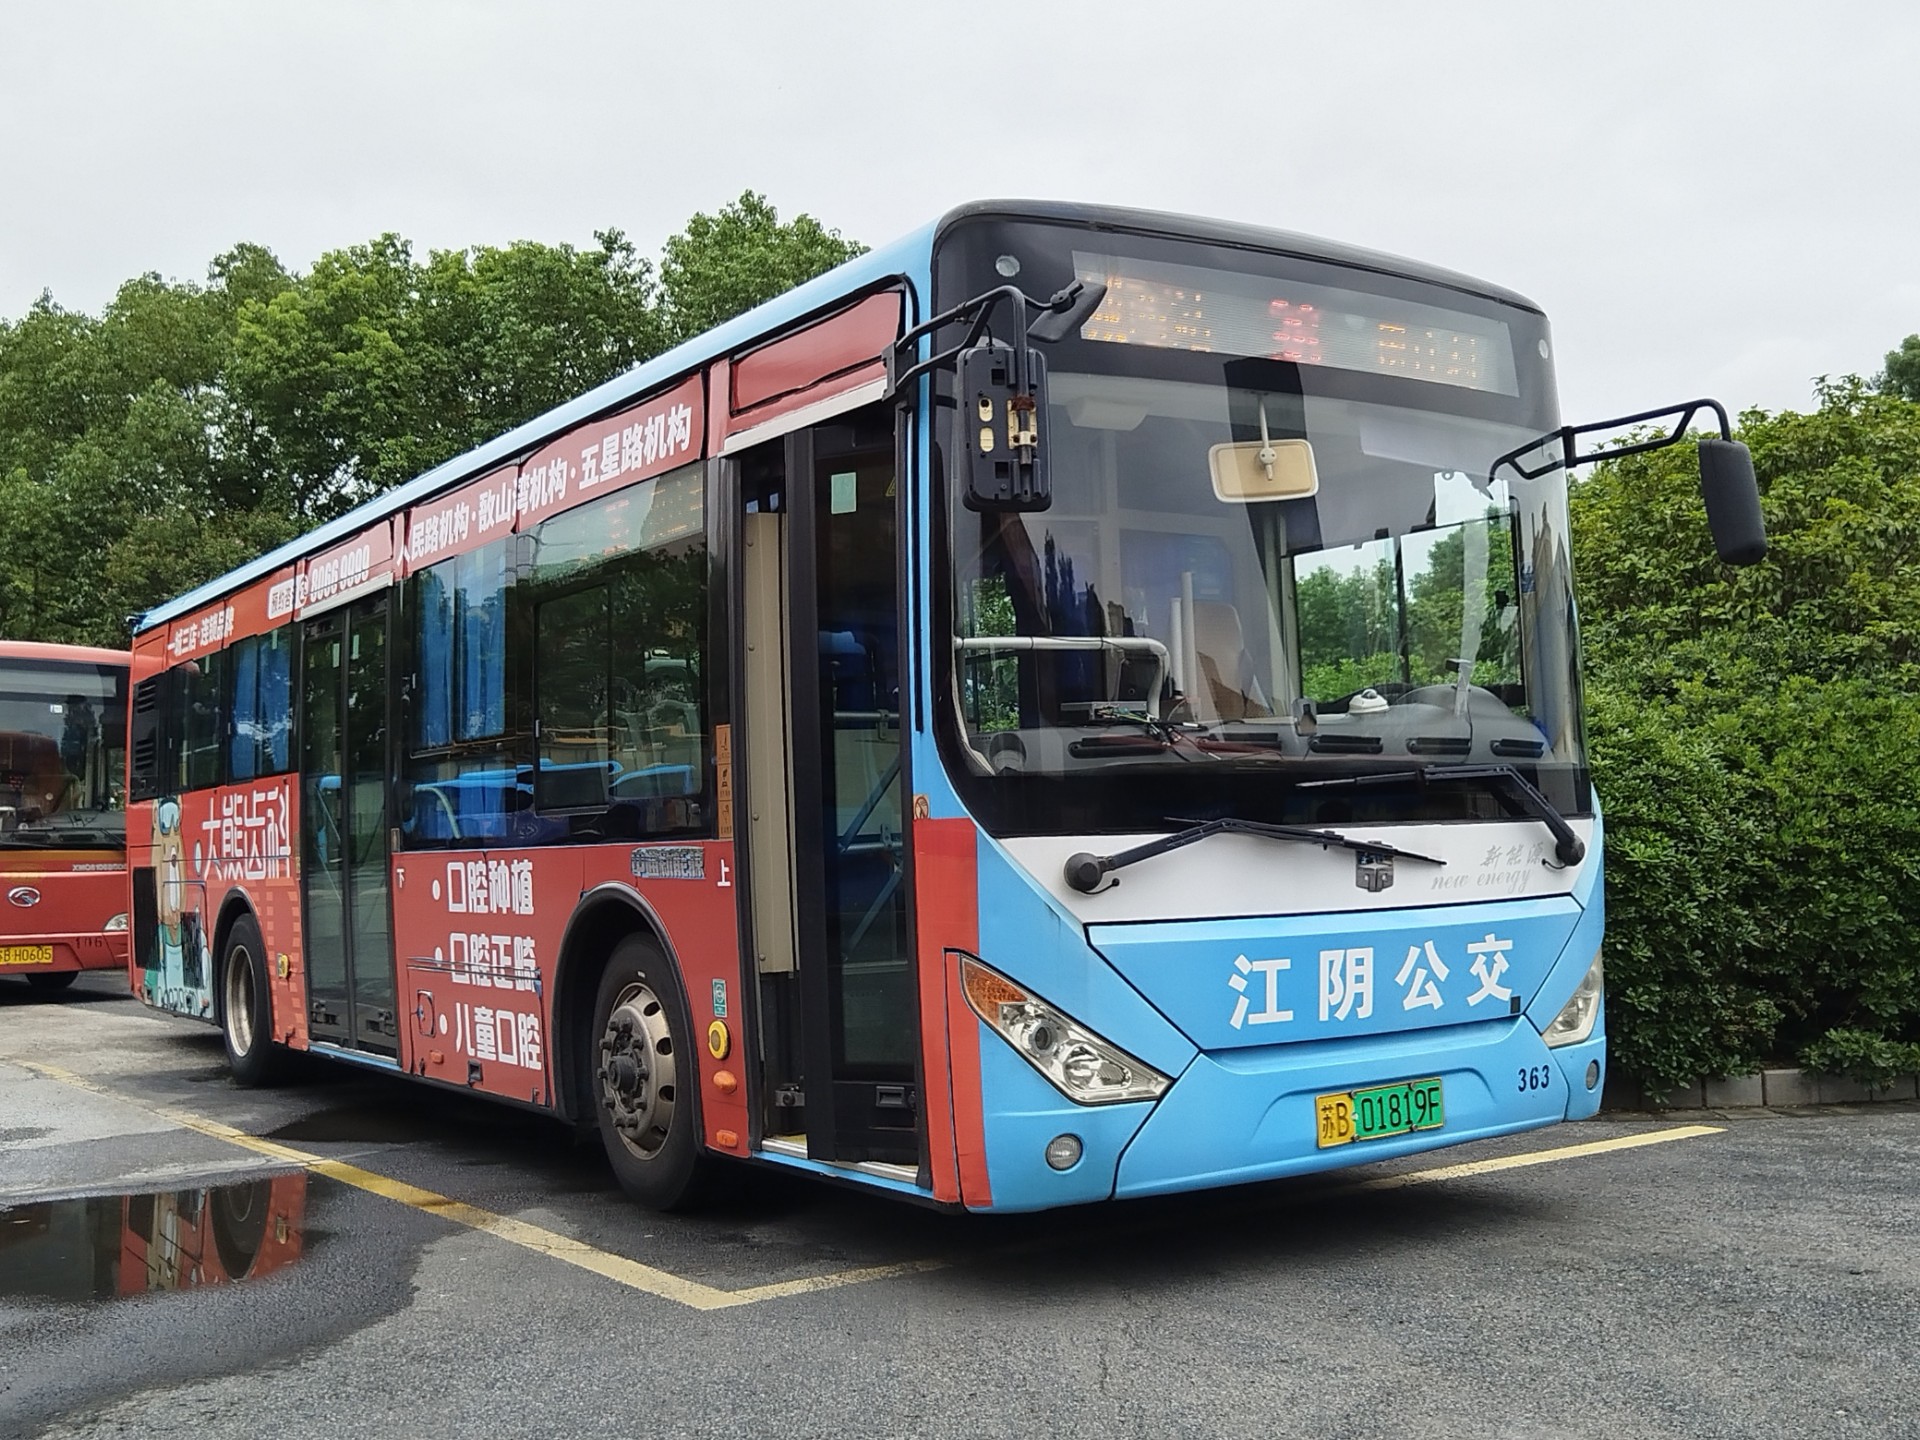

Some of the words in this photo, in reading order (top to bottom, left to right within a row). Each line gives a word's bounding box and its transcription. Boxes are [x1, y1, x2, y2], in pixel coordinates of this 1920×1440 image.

[202, 785, 291, 880] 大熊齿科
[397, 868, 405, 888] 下
[447, 859, 534, 915] 口腔种植
[717, 859, 731, 886] 上
[1431, 873, 1468, 890] new
[1477, 868, 1531, 893] energy
[450, 932, 537, 993] 口腔正畸
[1228, 933, 1513, 1030] 江阴公交
[455, 1002, 542, 1071] 儿童口腔
[1518, 1065, 1550, 1092] 363
